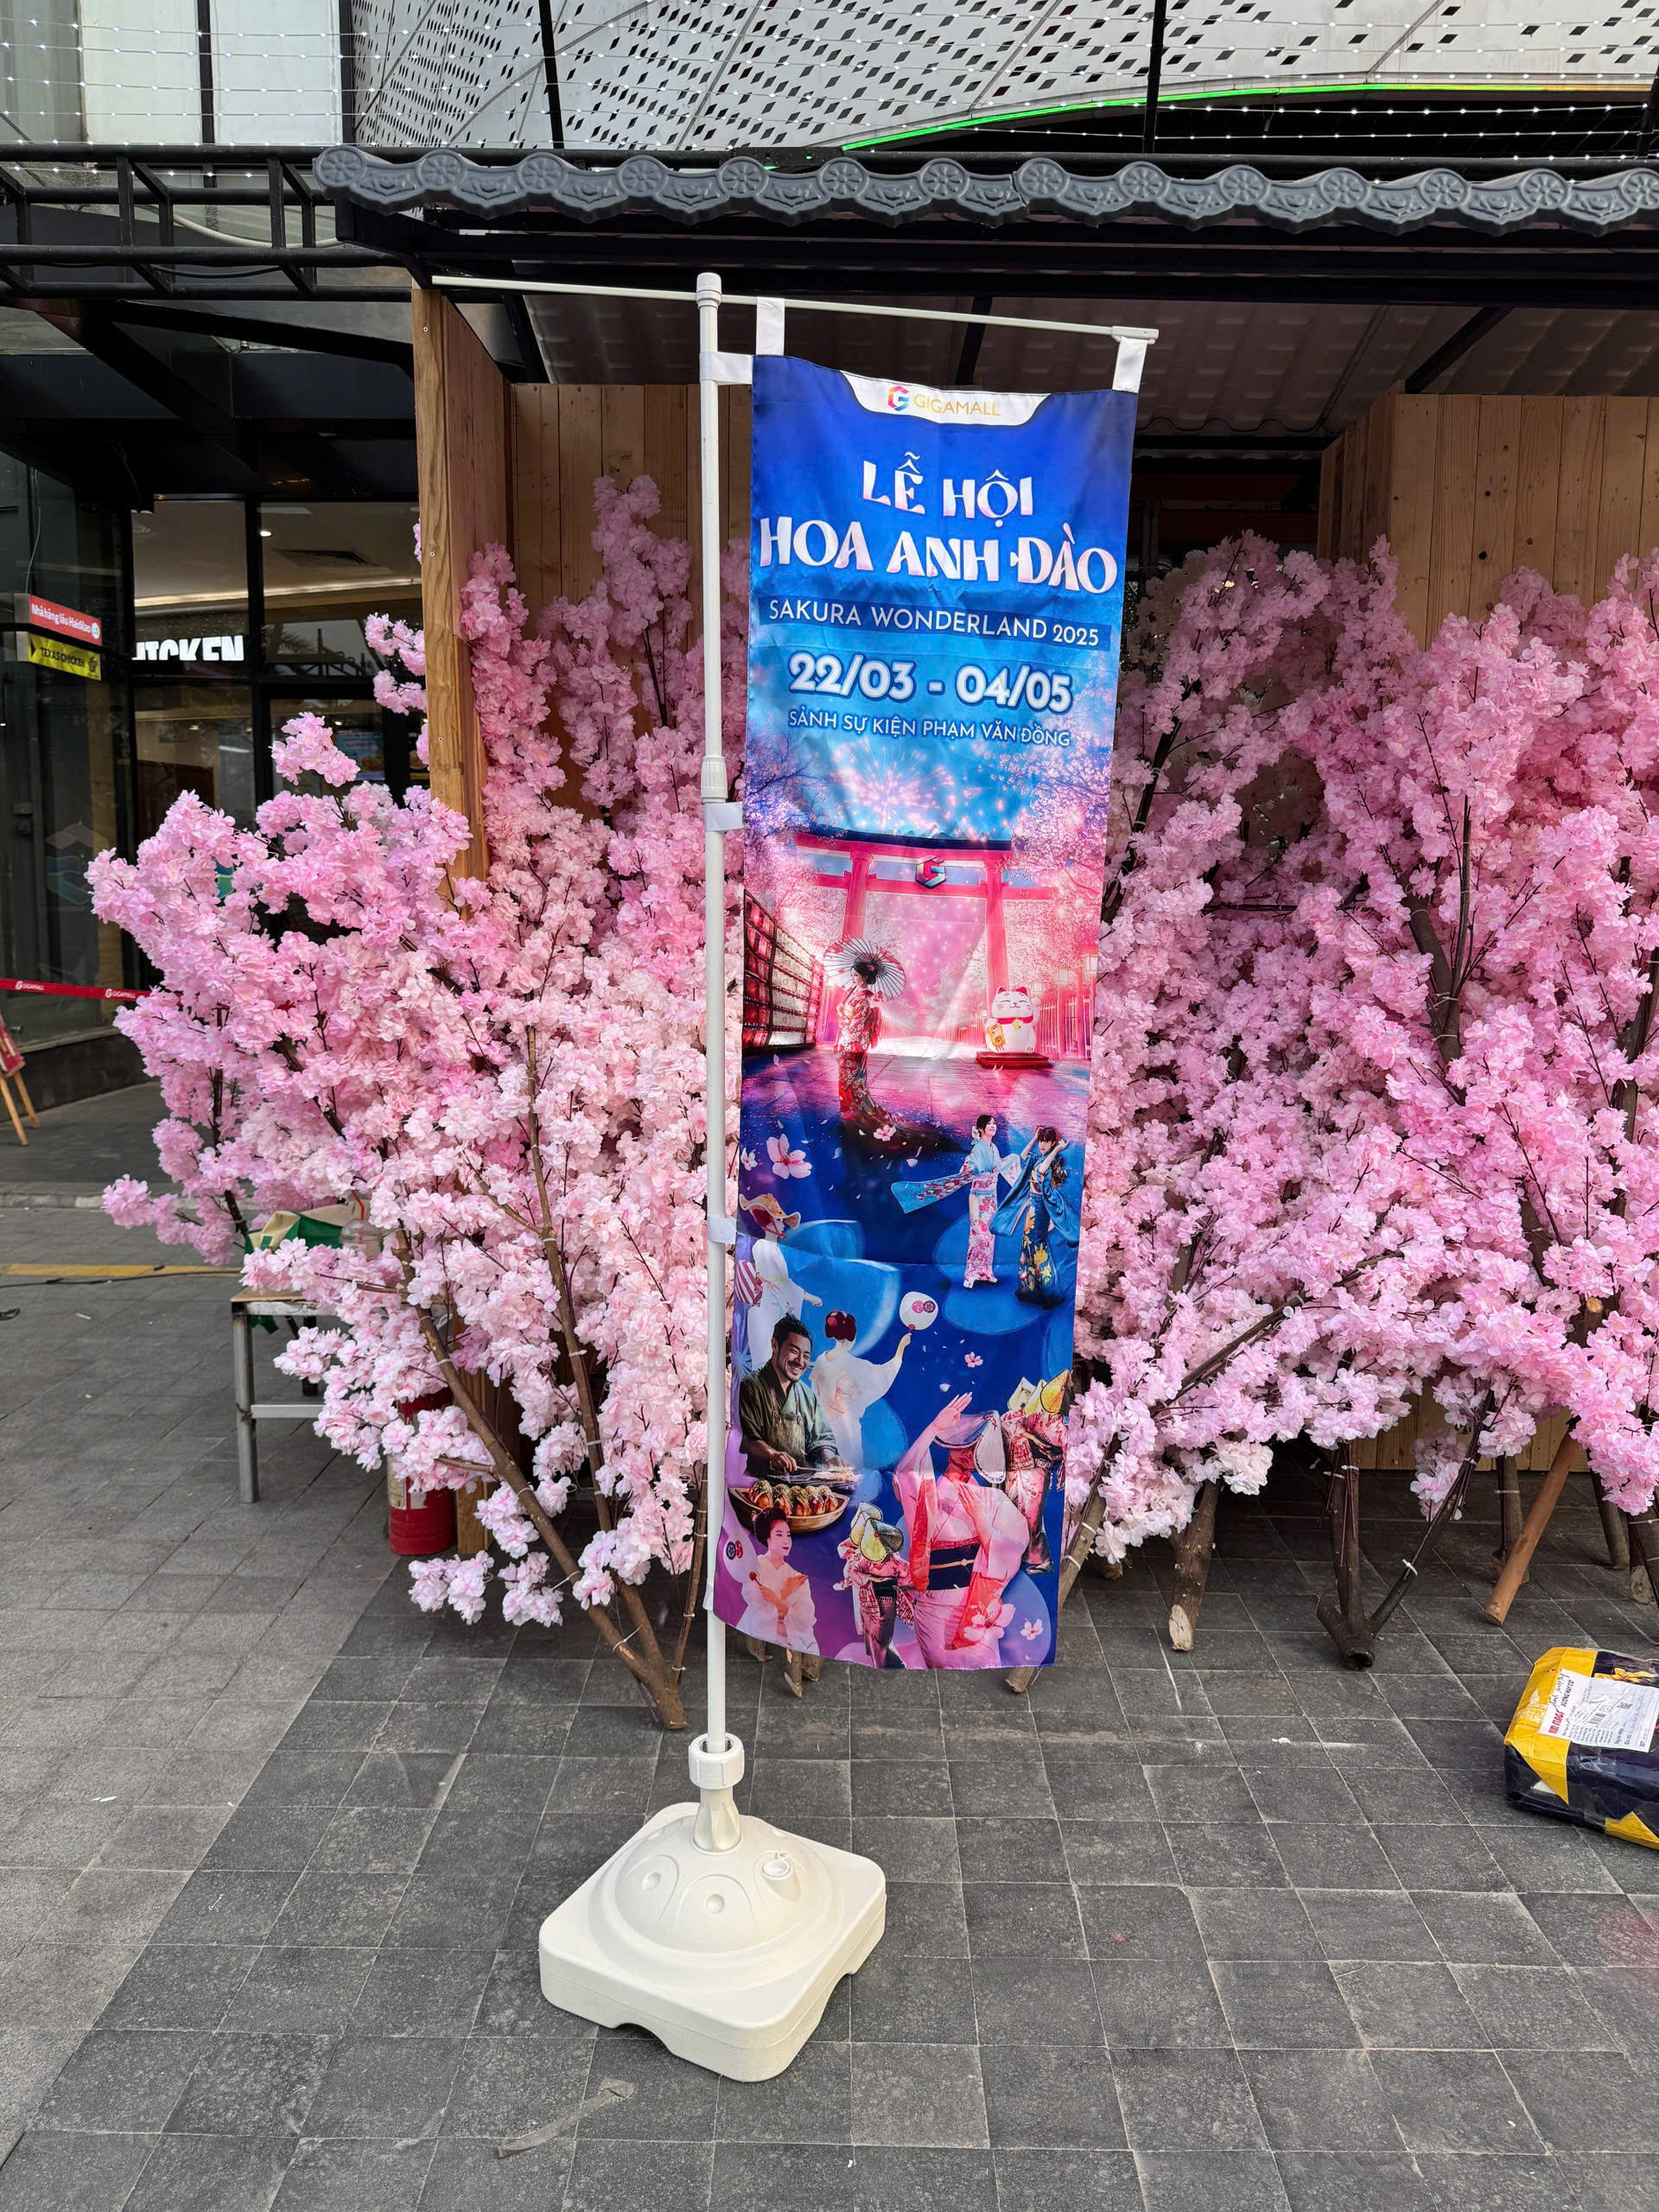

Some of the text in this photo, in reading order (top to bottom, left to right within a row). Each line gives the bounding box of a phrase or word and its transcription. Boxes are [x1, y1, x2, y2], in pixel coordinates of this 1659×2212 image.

[913, 393, 1001, 416] GIGAMALL
[863, 451, 1034, 528] LỄ HỘI
[760, 517, 1118, 594] HOA ANH ĐÀO
[769, 600, 1100, 646] SAKURA WONDERLAND 2025
[788, 651, 916, 701] 22/03
[956, 664, 1073, 714] 04/05
[789, 705, 1071, 747] SẢNH SỰ KIỆN PHẠM VĂN ĐỒNG
